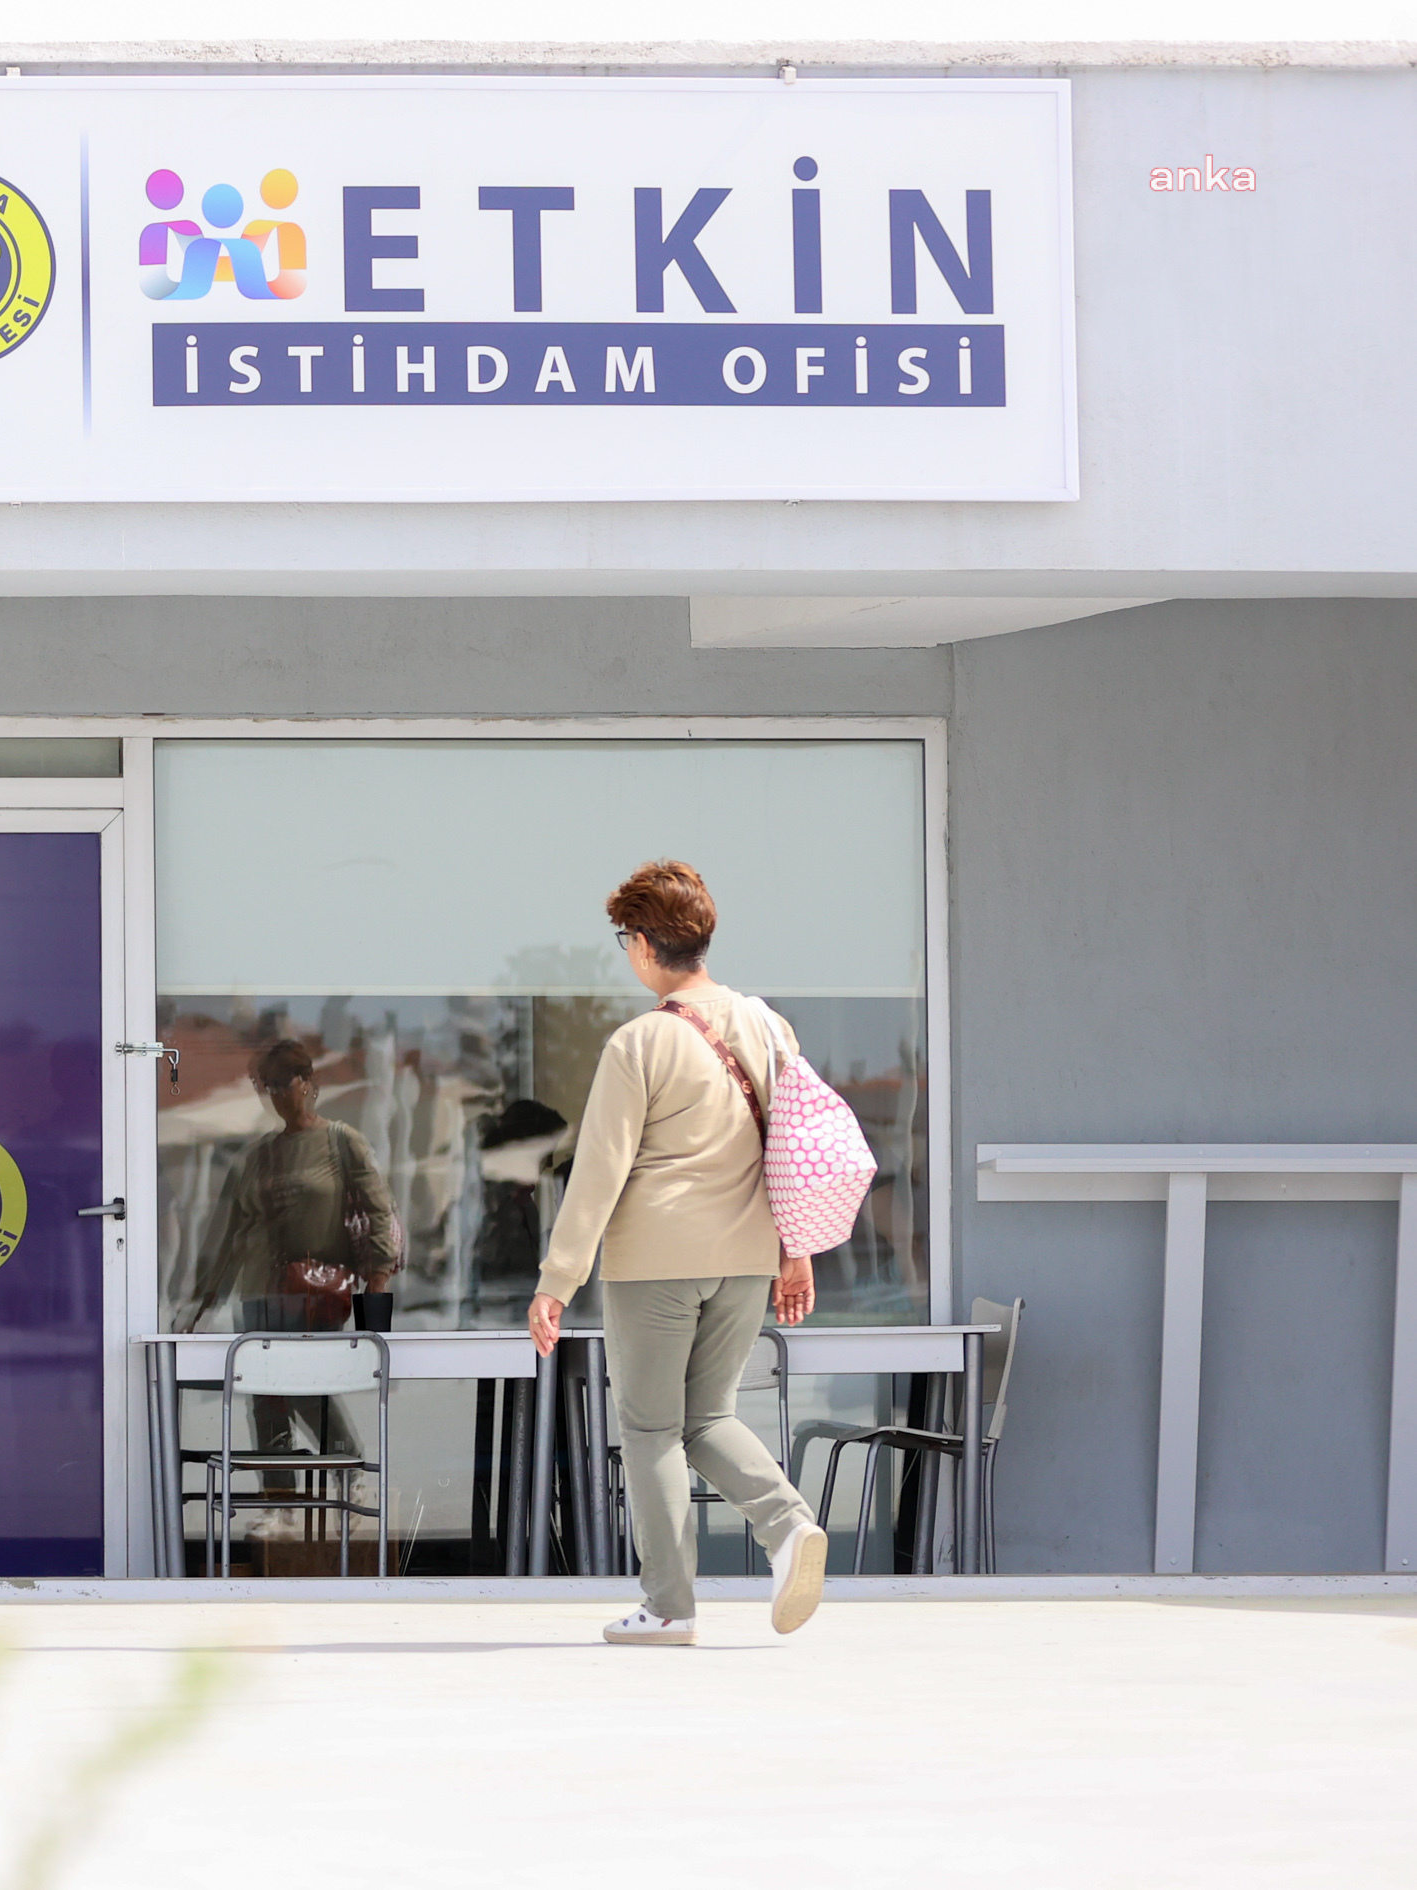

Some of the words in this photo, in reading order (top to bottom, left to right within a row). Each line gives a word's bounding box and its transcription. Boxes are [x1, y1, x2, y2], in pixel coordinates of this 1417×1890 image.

[342, 155, 994, 314] ETKİN
[184, 334, 658, 395] İSTİHDAM
[720, 335, 974, 395] OFİSİ
